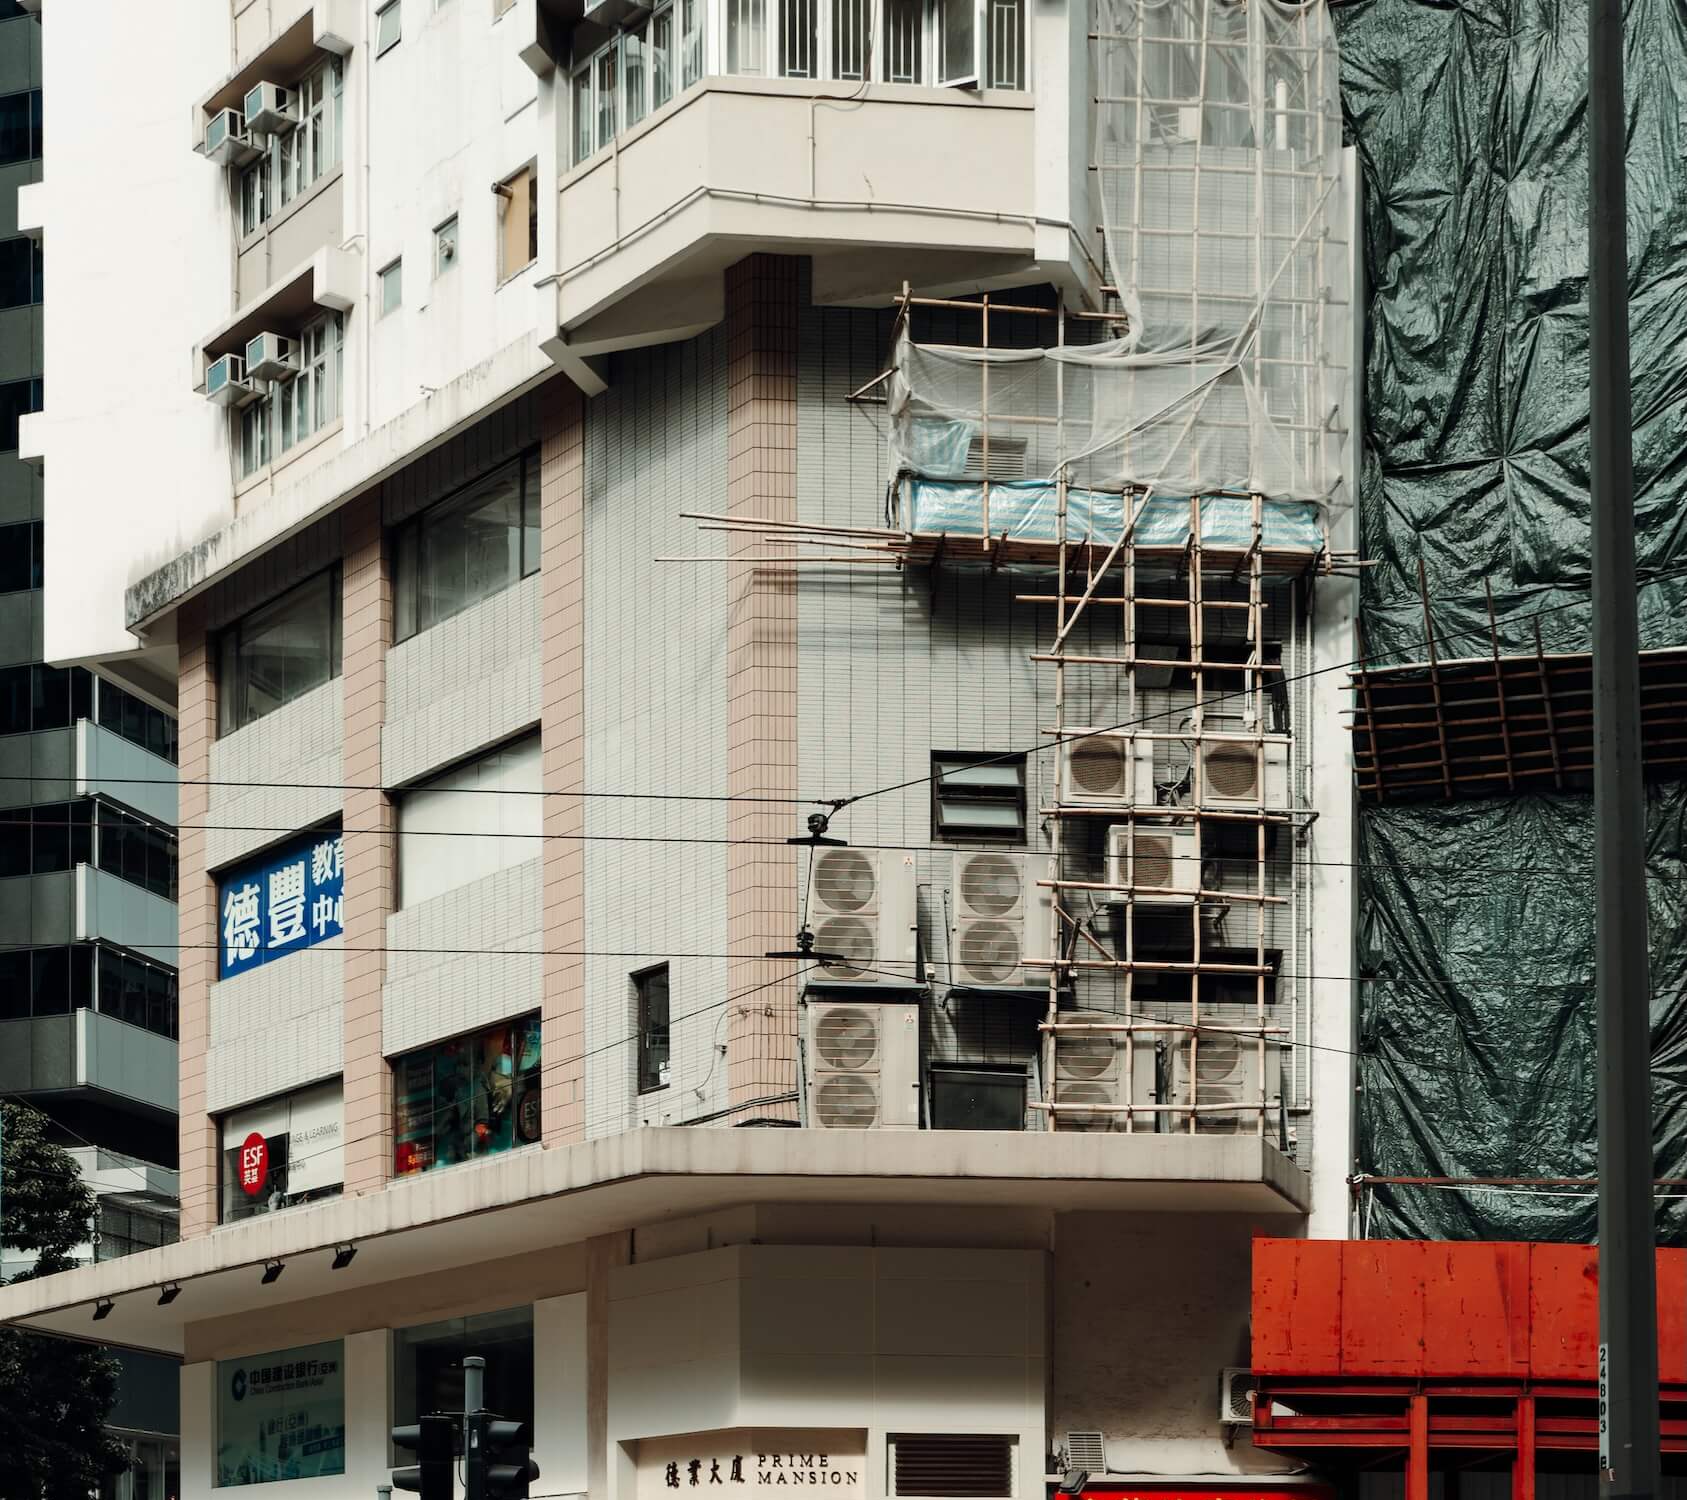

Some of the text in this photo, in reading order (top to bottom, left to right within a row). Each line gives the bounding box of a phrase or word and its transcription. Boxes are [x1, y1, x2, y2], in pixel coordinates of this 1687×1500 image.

[224, 861, 306, 967] 德豐
[243, 1145, 264, 1169] ESF
[758, 1454, 829, 1468] PRIME
[758, 1471, 858, 1485] MANSION
